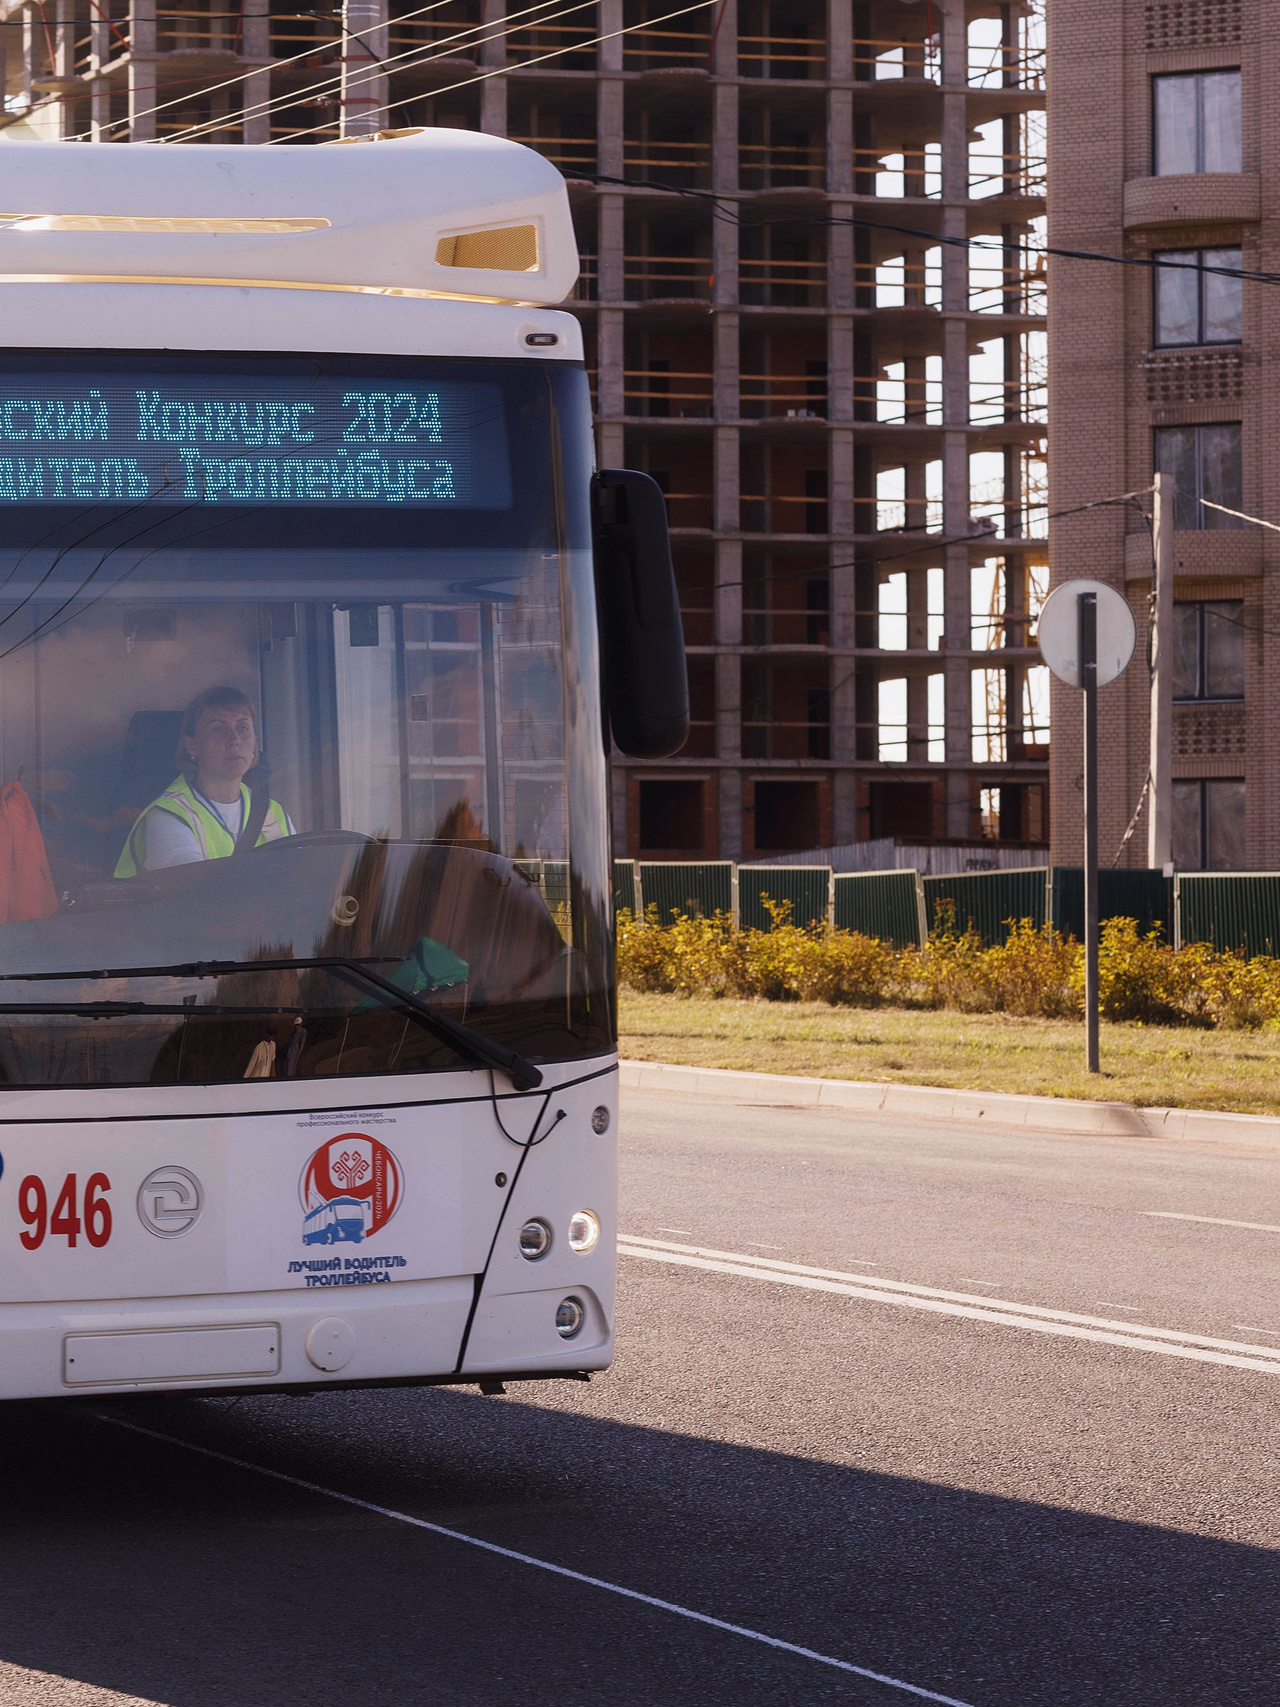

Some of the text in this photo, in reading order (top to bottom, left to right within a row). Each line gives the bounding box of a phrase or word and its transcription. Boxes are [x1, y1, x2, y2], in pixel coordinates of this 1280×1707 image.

[135, 389, 315, 444] Конкурс
[341, 392, 442, 442] 2024
[178, 447, 456, 501] Троллейбуса
[19, 1172, 112, 1250] 946
[287, 1255, 407, 1273] ЛУЧШИЙ ВОДИТЕЛЬ
[304, 1271, 392, 1287] ТРОЛЛЕЙБУСА
